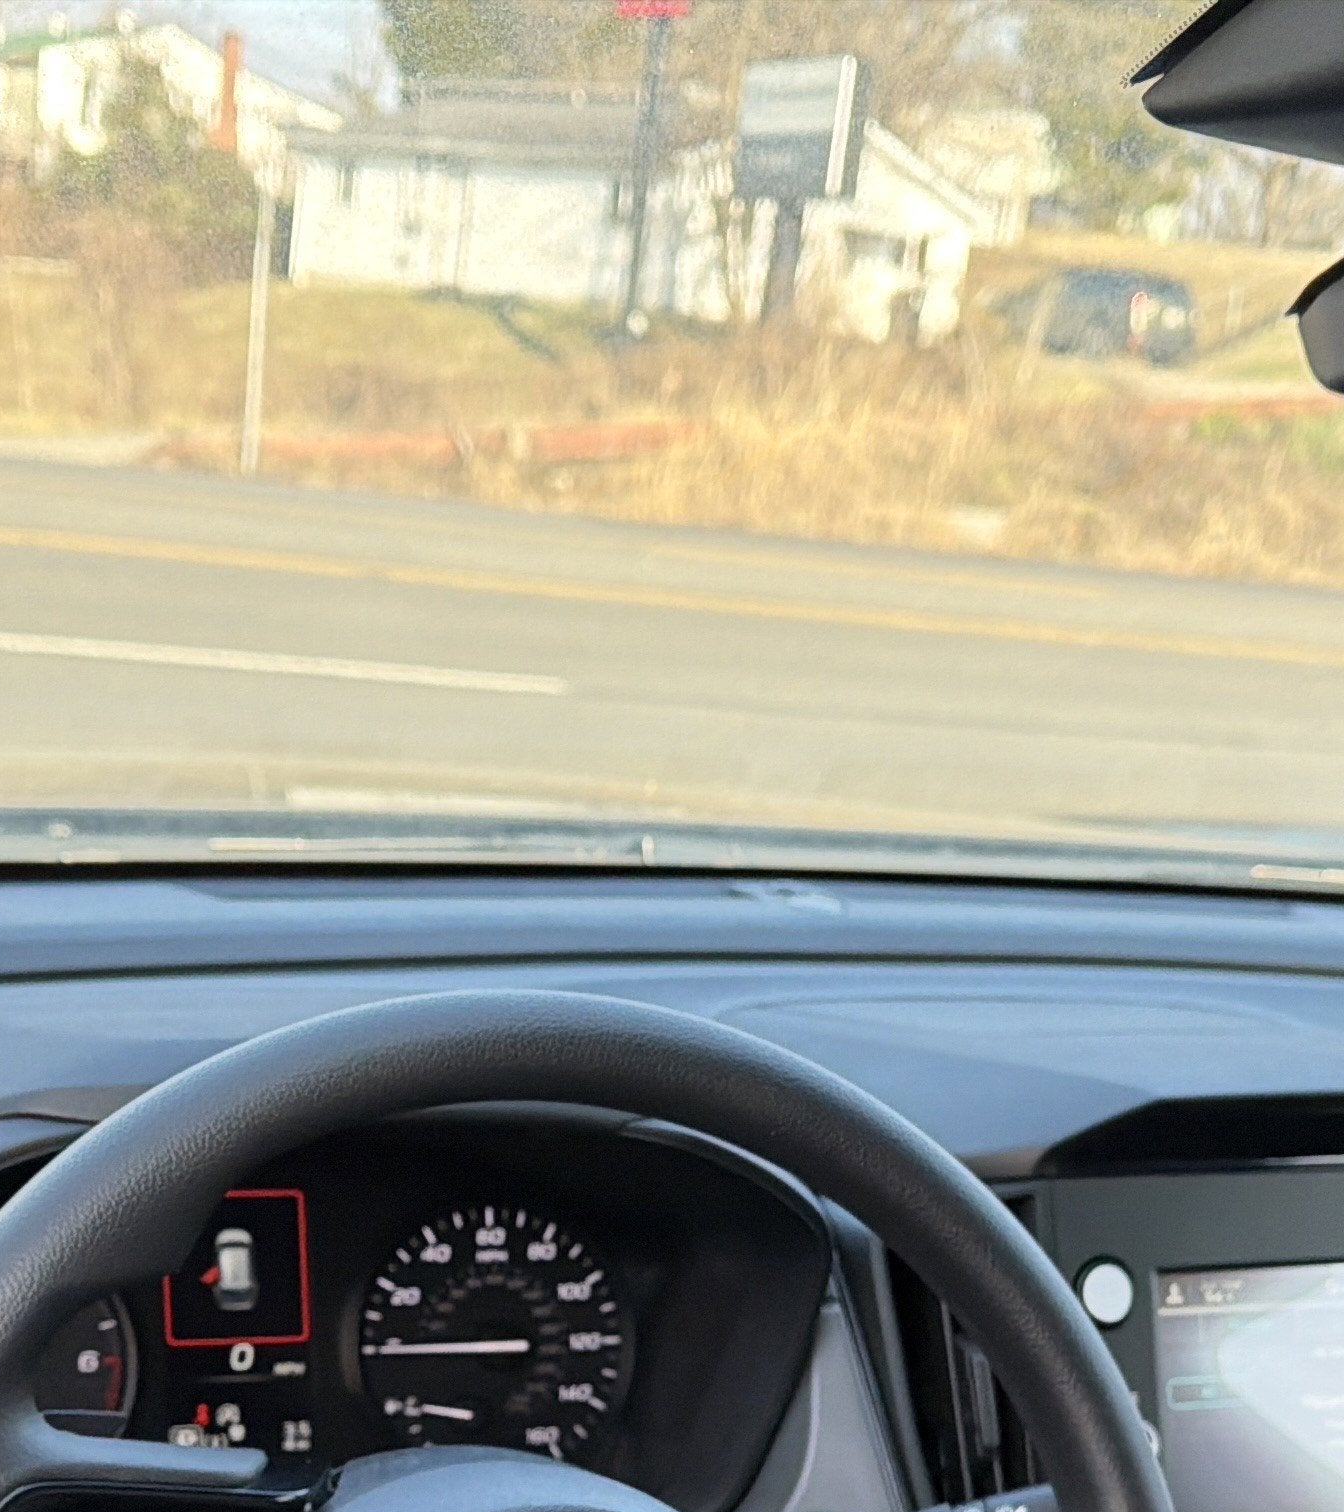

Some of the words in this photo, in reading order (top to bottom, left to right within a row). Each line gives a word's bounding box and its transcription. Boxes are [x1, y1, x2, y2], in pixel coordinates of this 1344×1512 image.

[475, 1226, 506, 1247] 60
[419, 1243, 452, 1263] 40
[390, 1286, 421, 1306] 20
[557, 1282, 592, 1301] 100
[569, 1332, 602, 1351] 120
[229, 1342, 255, 1372] 0
[558, 1383, 593, 1401] 140
[525, 1425, 560, 1445] 160
